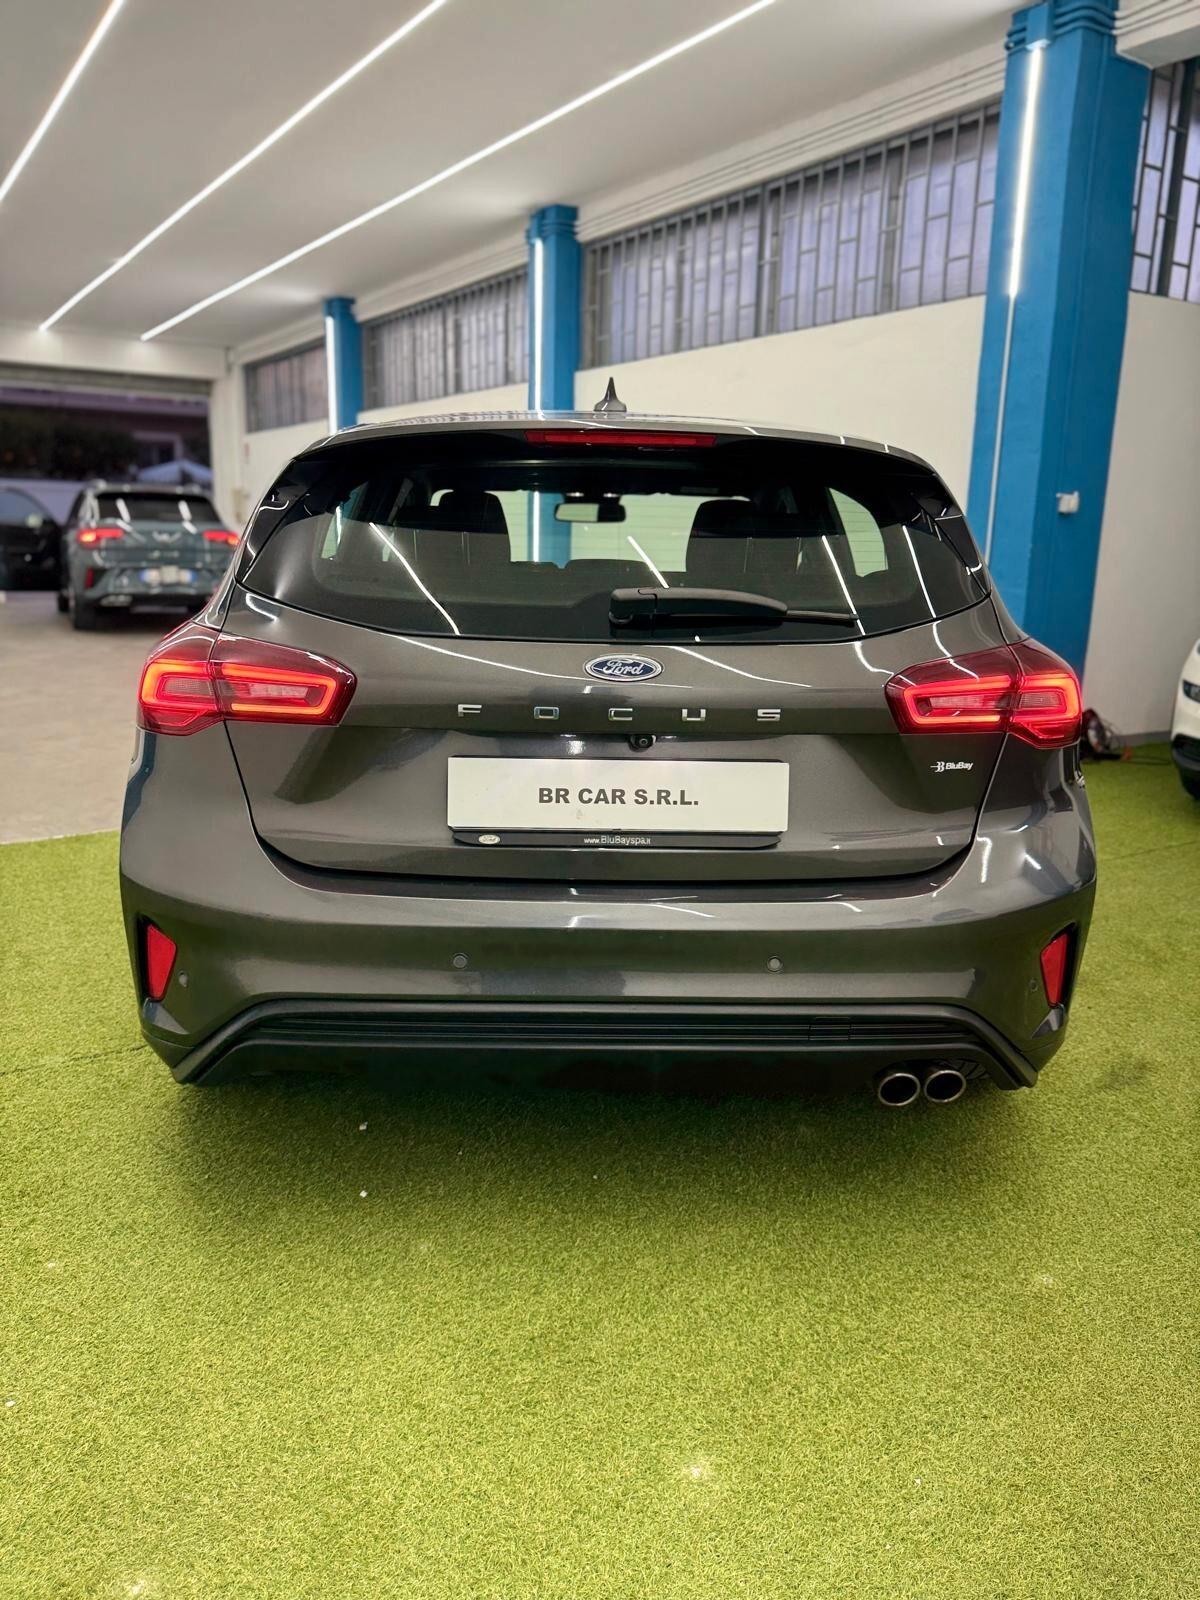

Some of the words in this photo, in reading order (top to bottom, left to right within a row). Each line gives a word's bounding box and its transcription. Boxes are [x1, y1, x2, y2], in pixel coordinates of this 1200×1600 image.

[602, 659, 644, 676] Ford
[457, 704, 781, 722] FOCUS
[945, 761, 974, 770] BluBay
[538, 788, 570, 804] BR
[578, 788, 626, 805] CAR
[634, 789, 699, 805] S.R.L.
